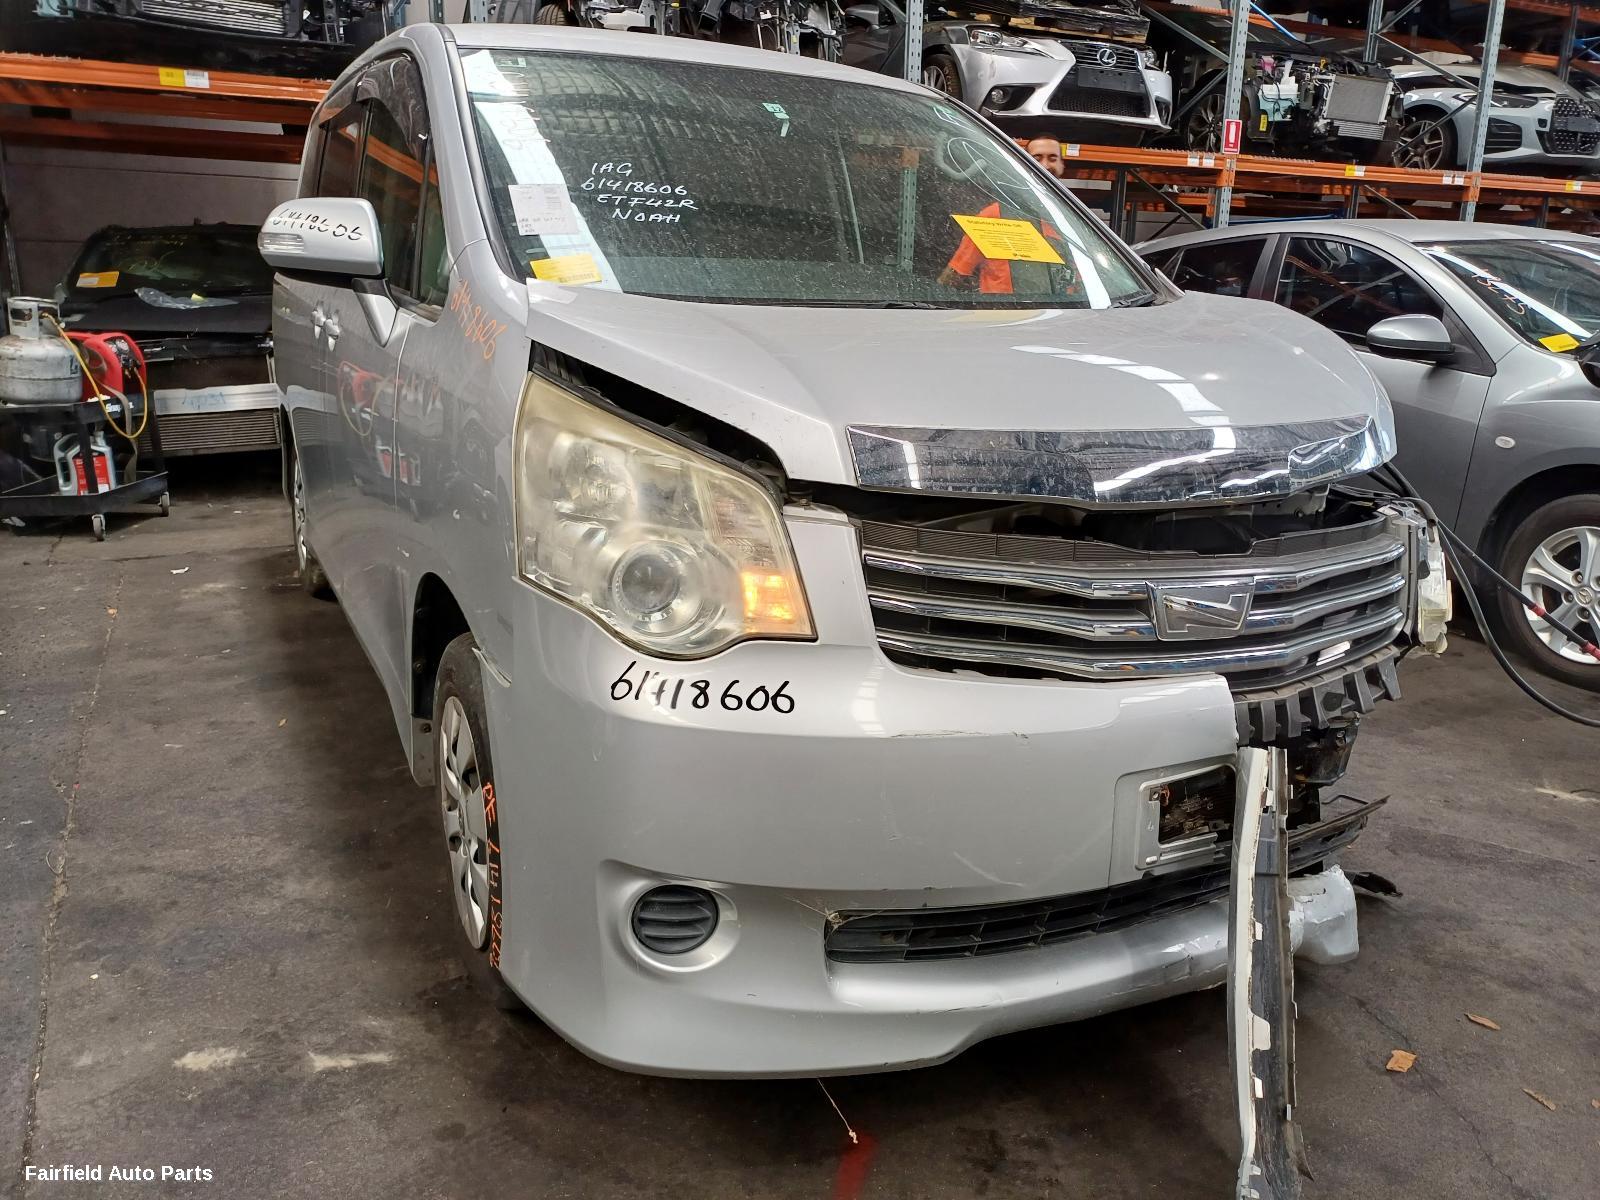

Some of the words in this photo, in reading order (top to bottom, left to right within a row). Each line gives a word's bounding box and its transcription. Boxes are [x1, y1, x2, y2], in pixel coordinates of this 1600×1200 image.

[580, 177, 688, 196] 61418606
[612, 208, 681, 224] NOAH
[610, 660, 796, 715] 61418606
